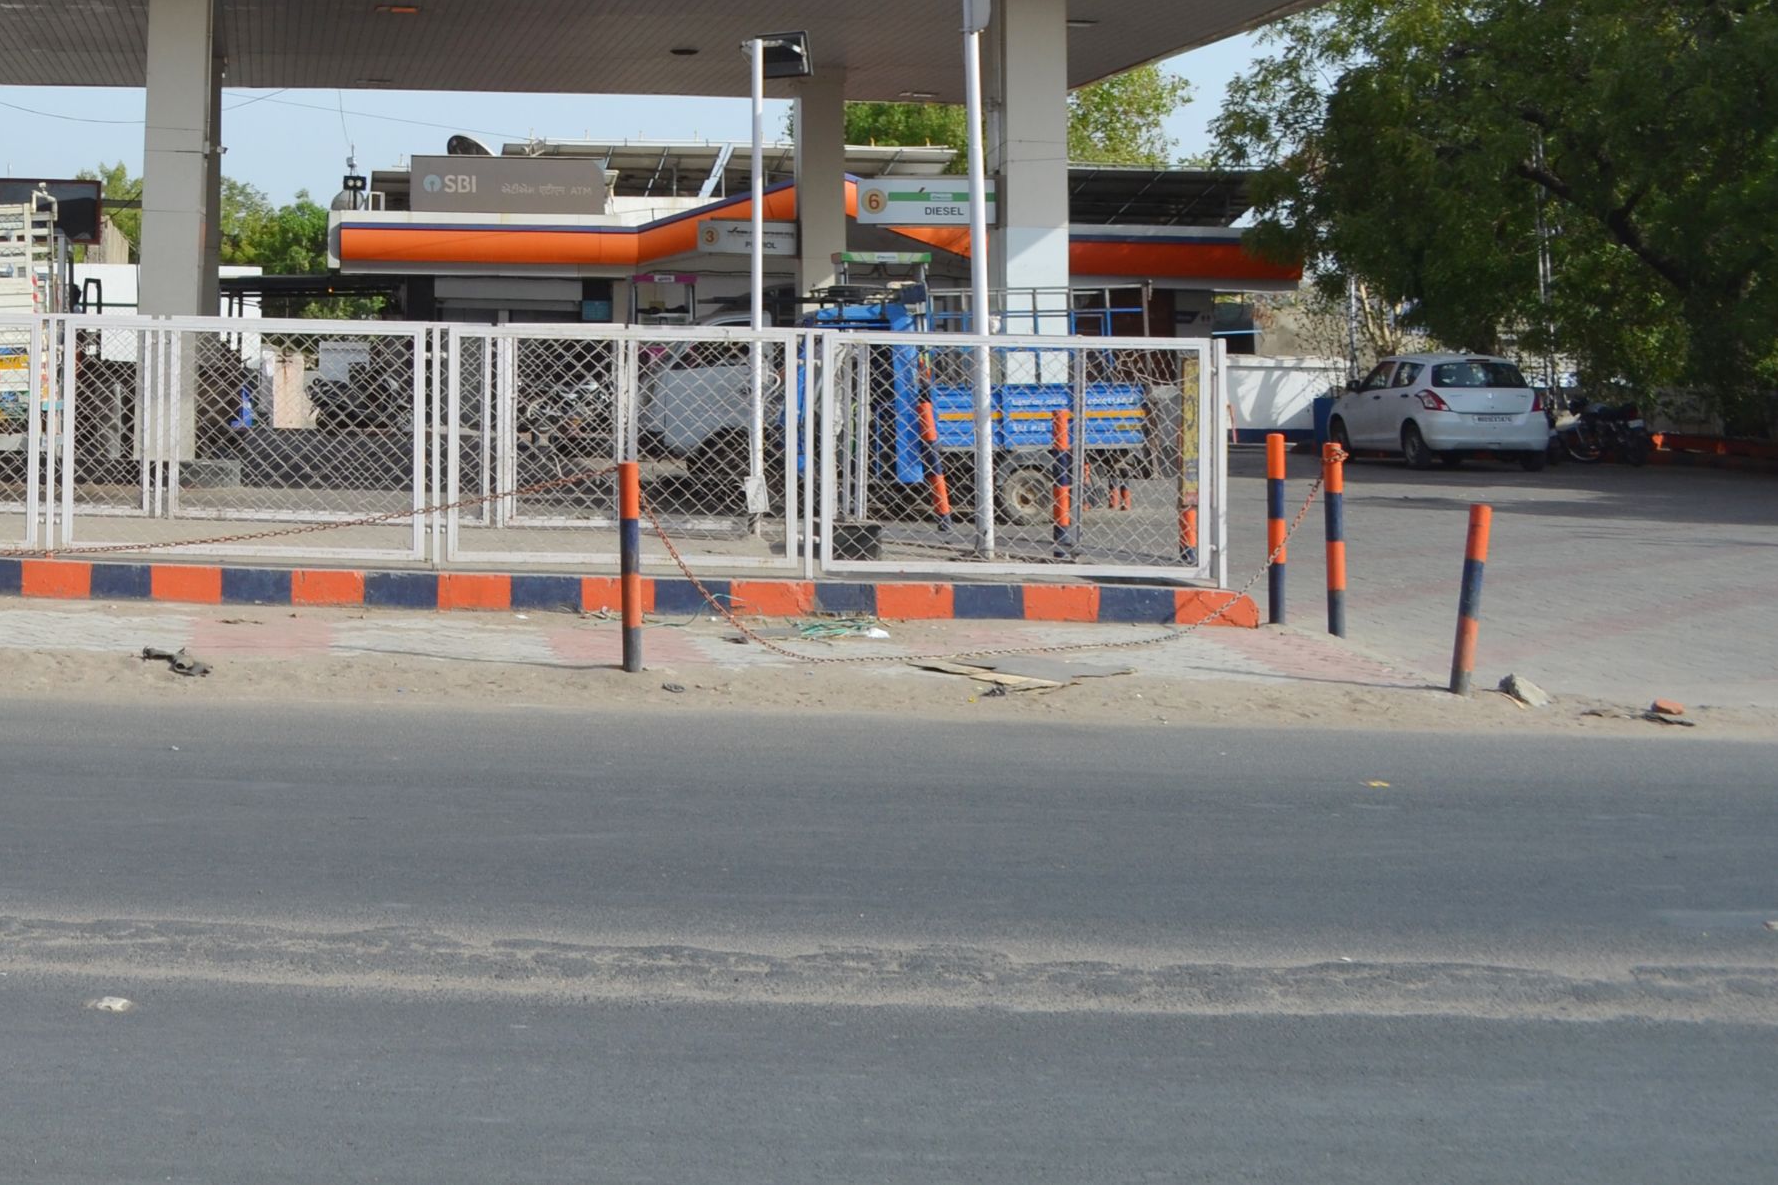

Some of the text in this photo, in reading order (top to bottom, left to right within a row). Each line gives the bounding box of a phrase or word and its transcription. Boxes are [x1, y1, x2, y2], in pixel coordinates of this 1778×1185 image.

[444, 174, 477, 194] SBI
[571, 186, 593, 196] ATM
[868, 193, 880, 210] 6
[924, 206, 964, 216] DIESEL
[704, 229, 716, 243] 3
